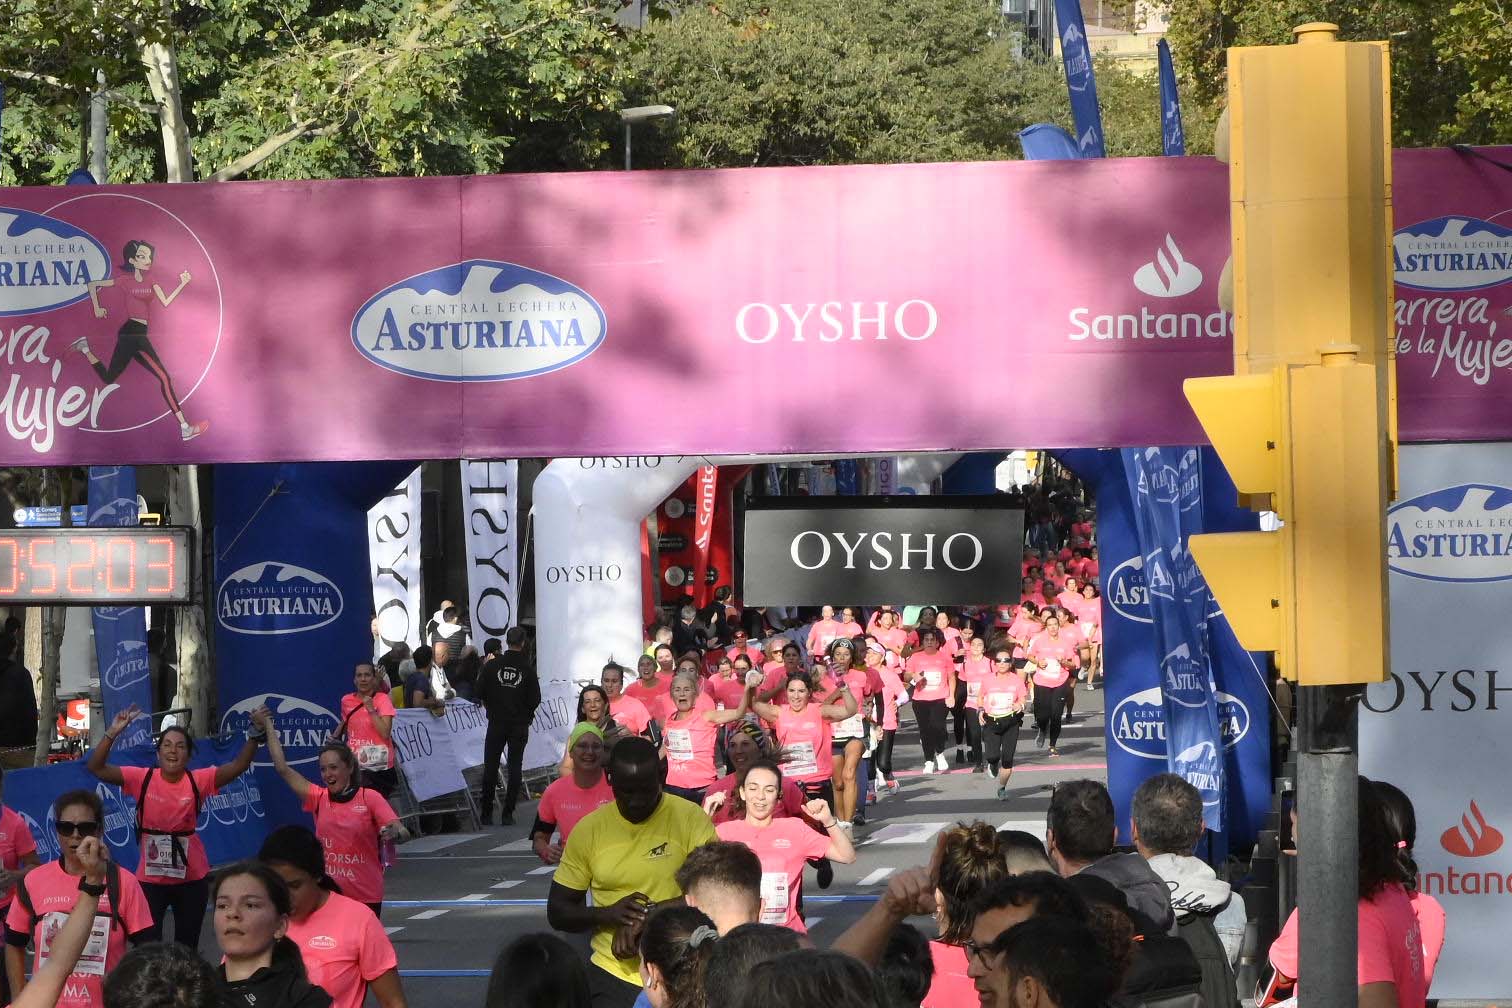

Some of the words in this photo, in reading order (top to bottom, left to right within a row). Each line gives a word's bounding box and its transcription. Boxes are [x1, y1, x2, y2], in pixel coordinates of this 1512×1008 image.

[12, 243, 86, 255] LECHERA
[1408, 241, 1458, 250] CENTRAL
[410, 304, 489, 316] CENTRAL
[496, 301, 578, 313] LECHERA
[1393, 297, 1489, 326] arrera
[371, 307, 587, 353] ASTURIANA
[734, 299, 939, 345] OYSHO
[1068, 307, 1233, 341] Santand
[1417, 328, 1435, 354] la
[1431, 320, 1512, 386] Muje
[1415, 519, 1482, 529] CENTRAL
[789, 530, 985, 571] OYSHO
[546, 563, 622, 584] OYSHO
[221, 591, 334, 619] ASTURIANA
[502, 671, 517, 681] BP
[43, 895, 70, 905] OYSHO
